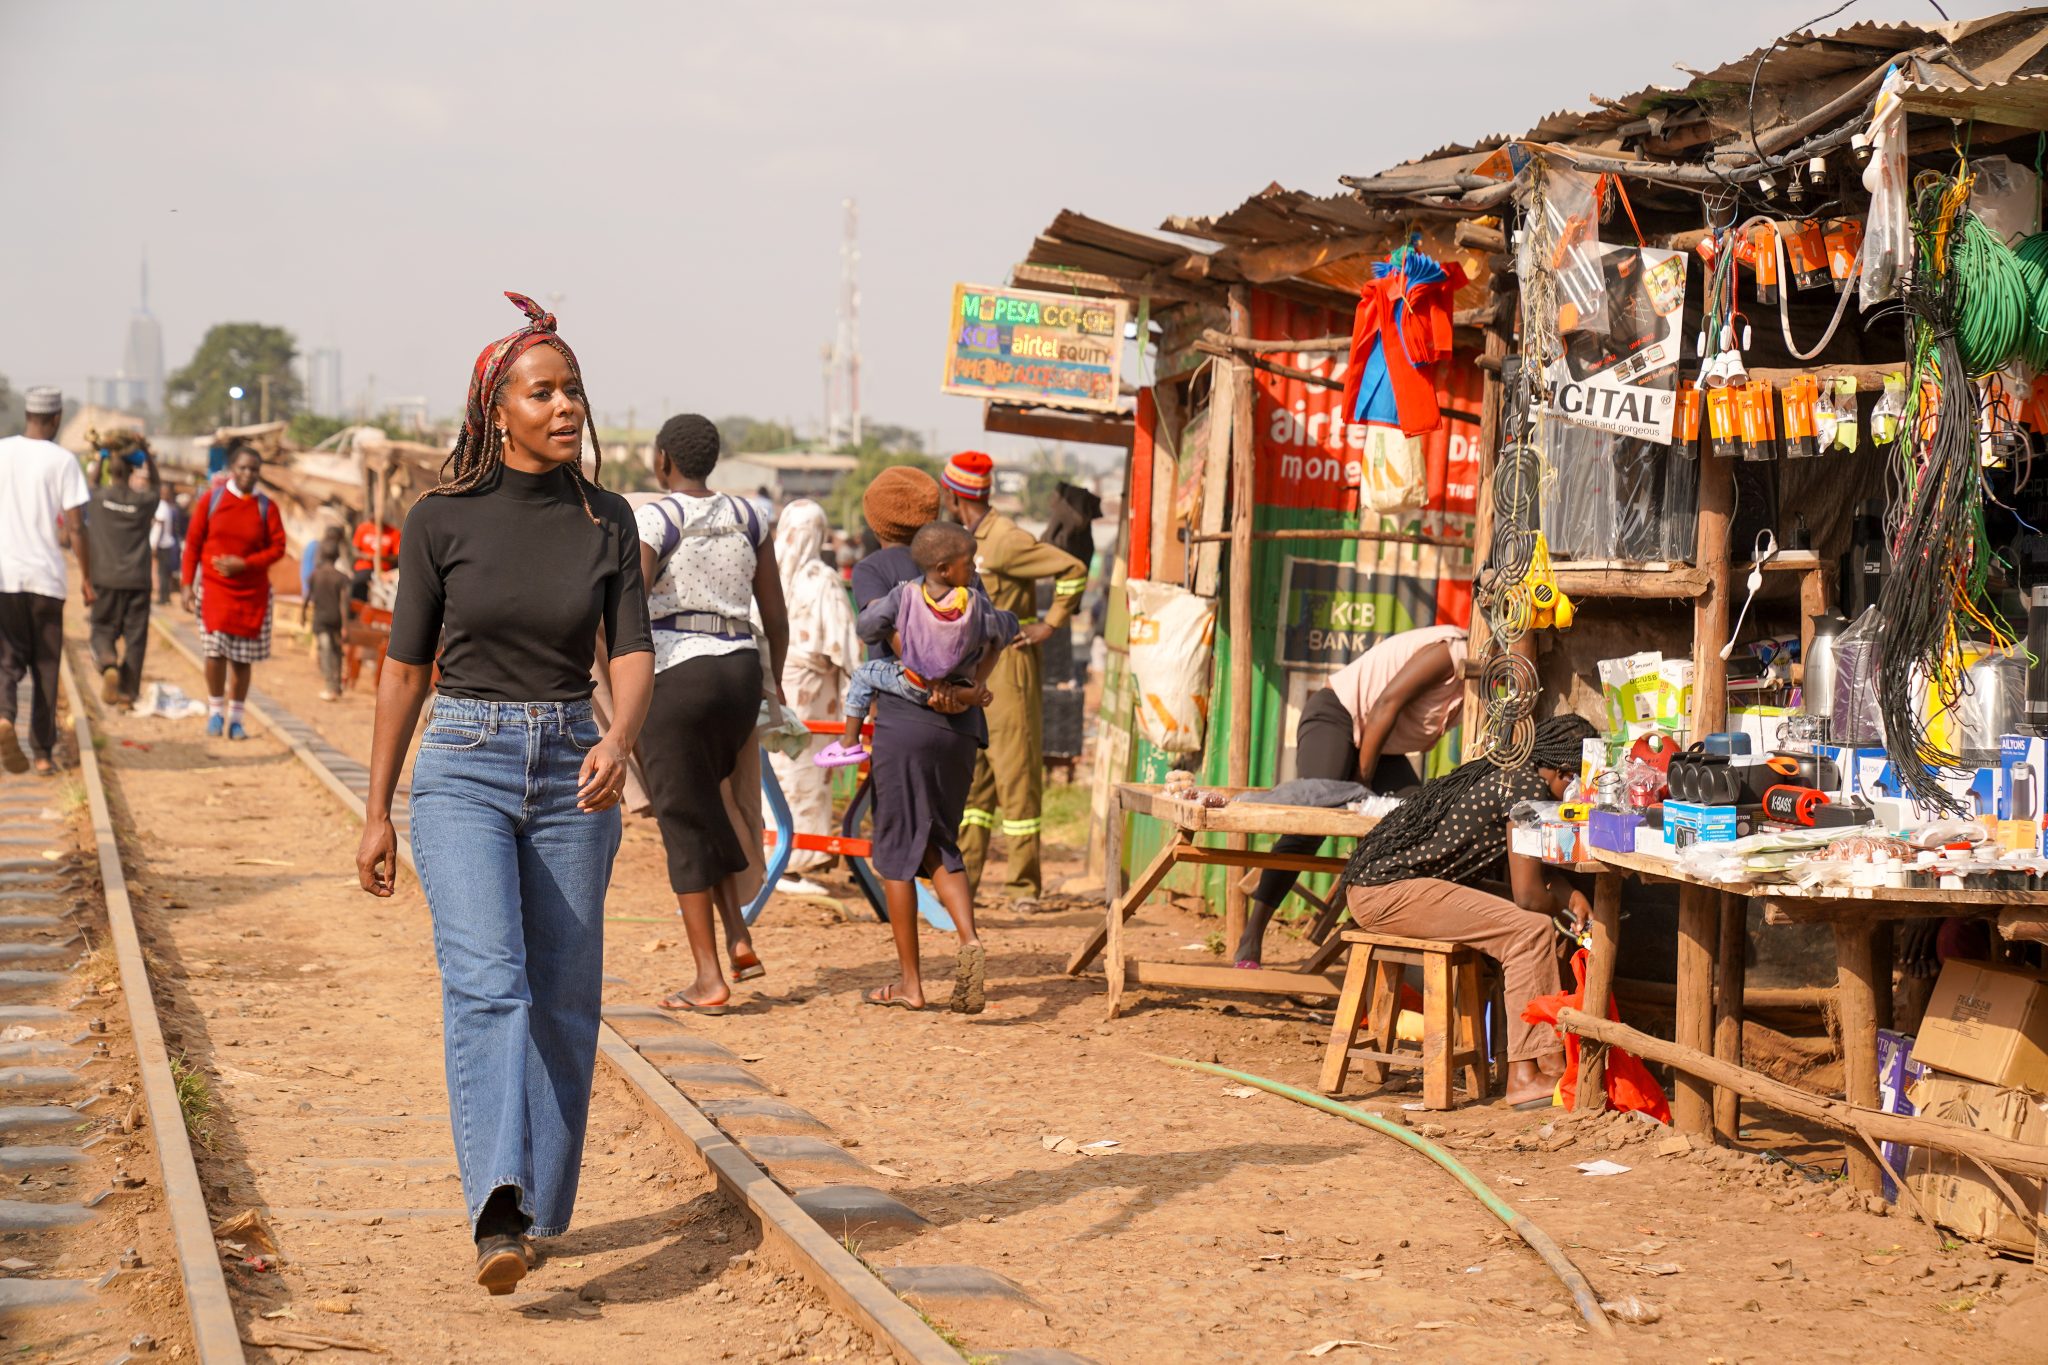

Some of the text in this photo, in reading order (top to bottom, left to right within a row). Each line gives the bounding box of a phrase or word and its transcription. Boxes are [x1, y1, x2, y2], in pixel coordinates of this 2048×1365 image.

[958, 326, 1111, 363] KCB airtel EQUITY
[1271, 400, 1367, 449] airte
[1576, 416, 1598, 428] great
[1600, 419, 1616, 430] and
[1618, 422, 1660, 437] gorgeous
[1281, 453, 1361, 484] mone
[1330, 601, 1376, 628] KCB
[1308, 630, 1368, 653] BANK
[1771, 795, 1793, 813] K-BASS
